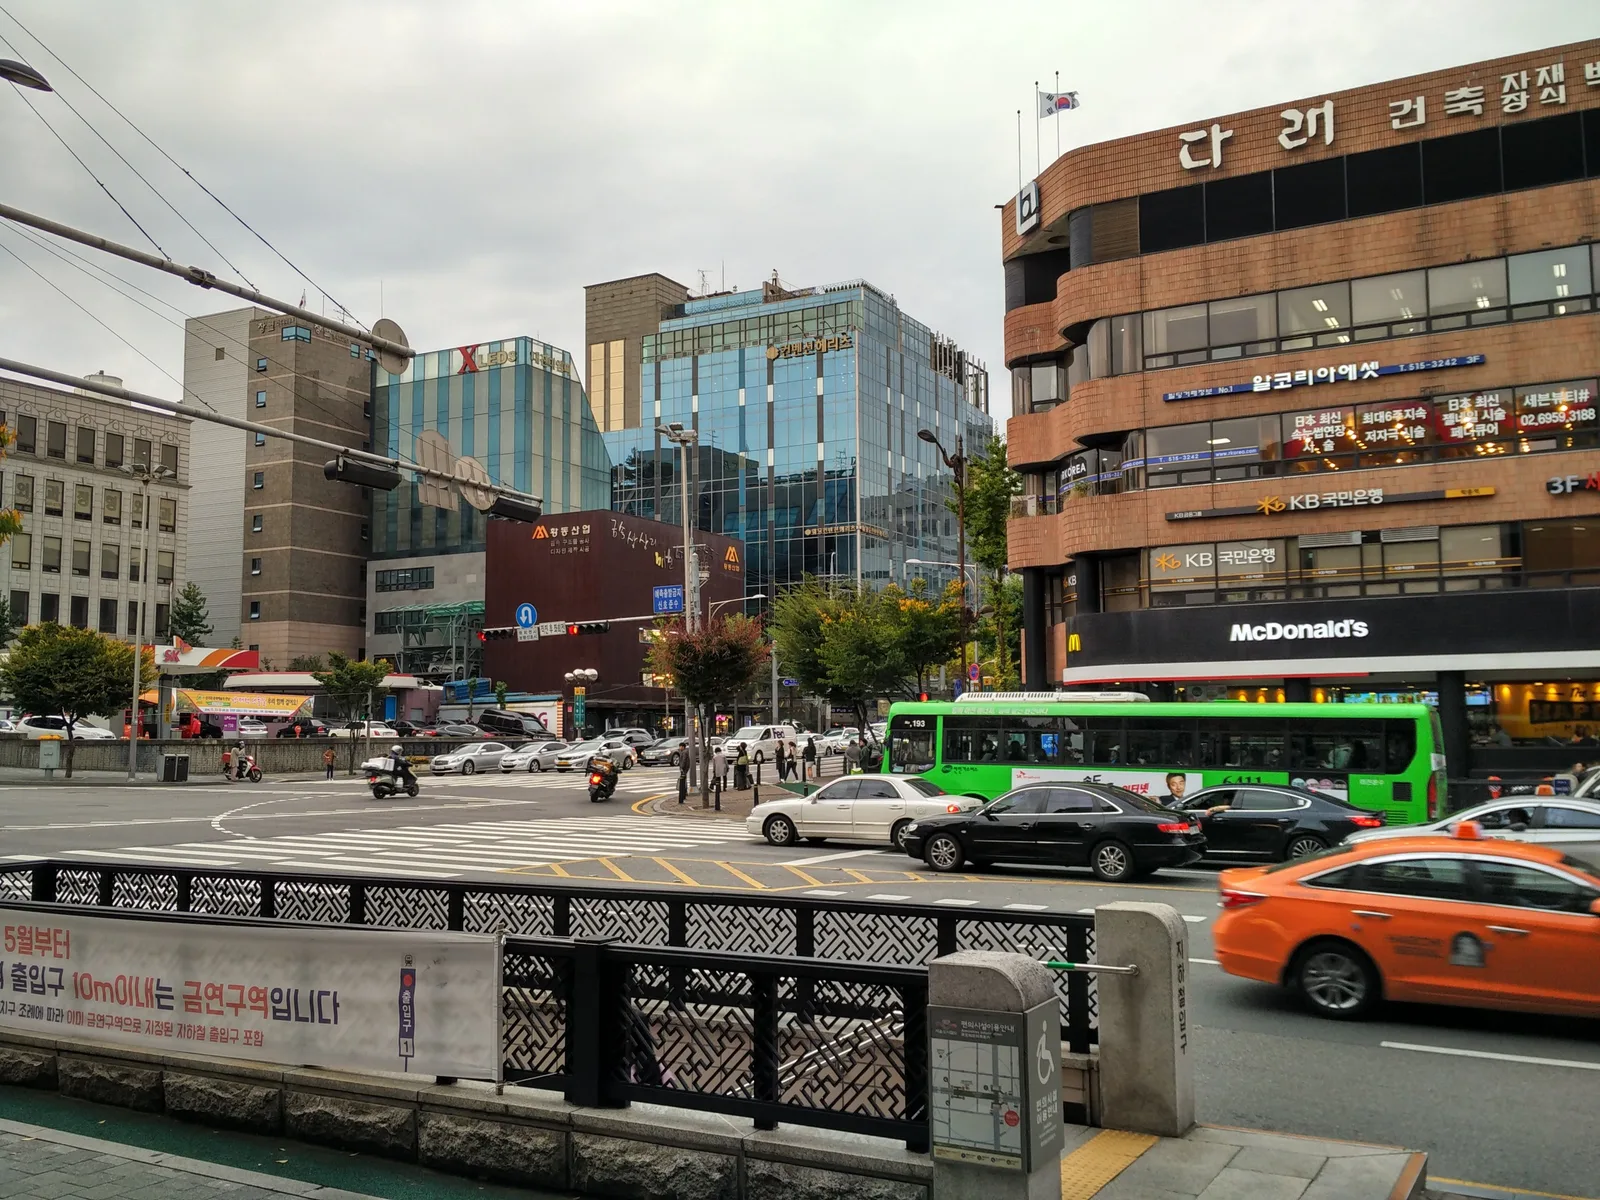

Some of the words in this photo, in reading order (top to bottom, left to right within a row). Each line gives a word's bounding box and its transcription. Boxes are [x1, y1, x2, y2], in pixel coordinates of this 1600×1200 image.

[1500, 63, 1565, 93] 자재
[1500, 85, 1566, 113] 장식
[780, 332, 853, 359] 컨벤션헤리츠
[1218, 385, 1233, 394] No.1
[1252, 361, 1379, 392] 알코리아에셋
[1409, 358, 1458, 371] 515-3242
[1466, 355, 1480, 364] 3F
[1448, 397, 1471, 411] 日本
[1475, 393, 1500, 408] 최신
[1524, 389, 1590, 407] 세븐뷰티#
[1295, 414, 1316, 428] 日本
[1320, 411, 1341, 425] 최신
[1362, 407, 1427, 425] 최대6주지속
[1442, 410, 1478, 426] 젤네일
[1482, 407, 1506, 422] 시술
[1291, 424, 1346, 440] 속눈썹연장
[1365, 429, 1399, 443] 저자극
[1401, 425, 1426, 439] 시술
[1451, 422, 1499, 439] 페디큐어
[1168, 454, 1199, 462] 515-3242
[1549, 475, 1580, 494] 3F
[1290, 494, 1320, 510] KB
[1322, 488, 1383, 507] 국민은행
[1186, 553, 1213, 568] KB
[1219, 548, 1276, 565] 국민은행
[1068, 575, 1077, 586] KB
[654, 587, 682, 598] 예측출발금지
[657, 599, 679, 610] 신호준수
[1230, 619, 1369, 641] McDonald's
[163, 649, 181, 662] SK
[4, 925, 70, 960] 5월부터
[11, 962, 65, 997] 출입구
[73, 971, 175, 1011] 10m이내는
[182, 980, 340, 1025] 금연구역입니다
[401, 990, 412, 1033] 출입구
[18, 1002, 43, 1020] 조례에
[46, 1006, 64, 1023] 따라
[66, 1009, 84, 1025] 이미
[87, 1012, 142, 1034] 금연구역으로
[145, 1019, 173, 1037] 지정된
[176, 1022, 206, 1041] 지하철
[209, 1026, 239, 1045] 출입구
[243, 1029, 264, 1047] 포함
